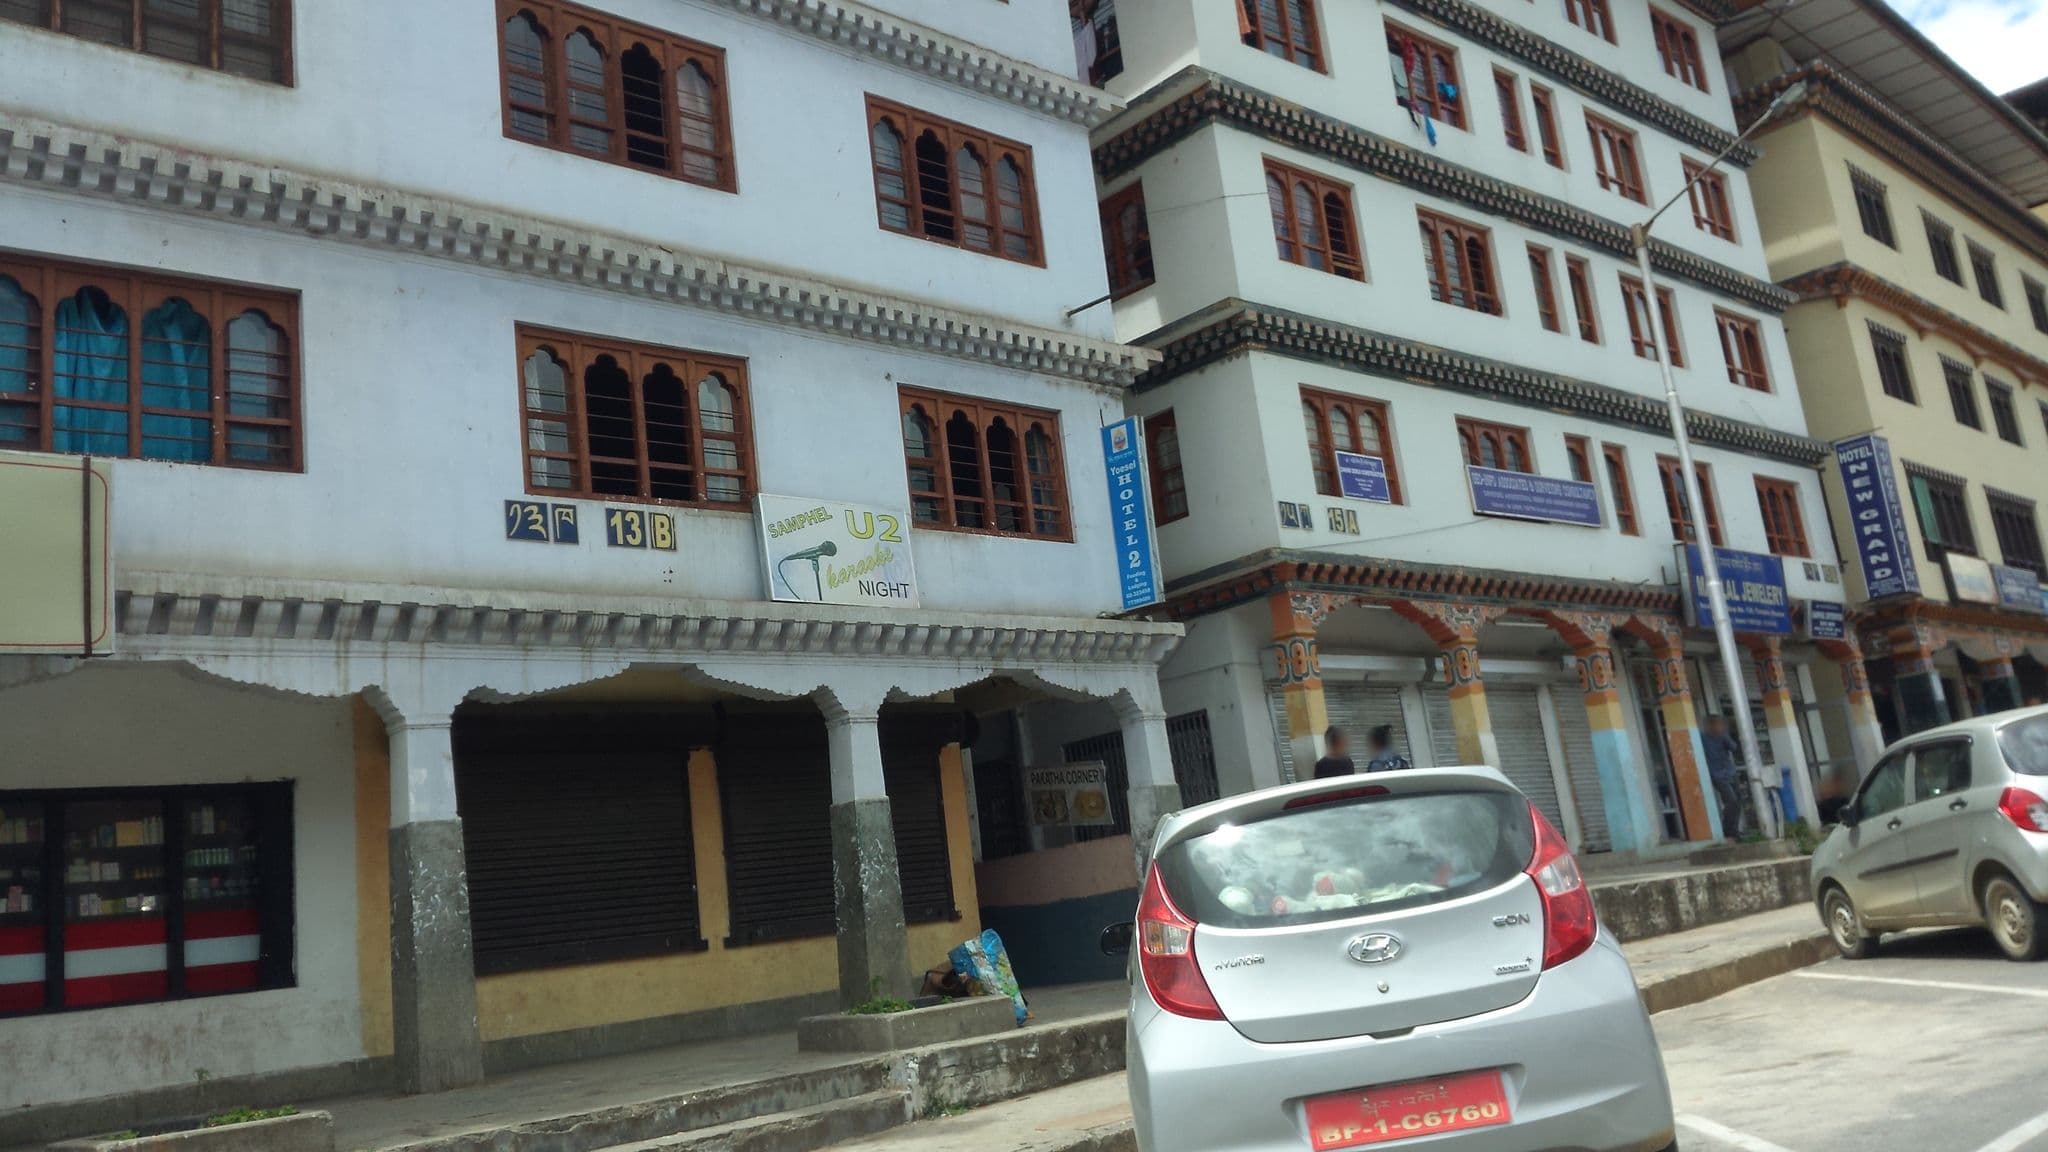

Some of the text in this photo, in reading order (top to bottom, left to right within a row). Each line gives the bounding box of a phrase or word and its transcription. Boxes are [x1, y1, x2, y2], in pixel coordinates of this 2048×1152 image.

[1838, 445, 1873, 464] HOTEL
[768, 506, 833, 538] SAMPHEL
[845, 509, 902, 542] U2
[1118, 473, 1138, 546] HOTEL
[1128, 550, 1141, 569] 2
[858, 580, 910, 599] NIGHT
[1066, 769, 1098, 785] CORNER
[1492, 913, 1530, 927] EON
